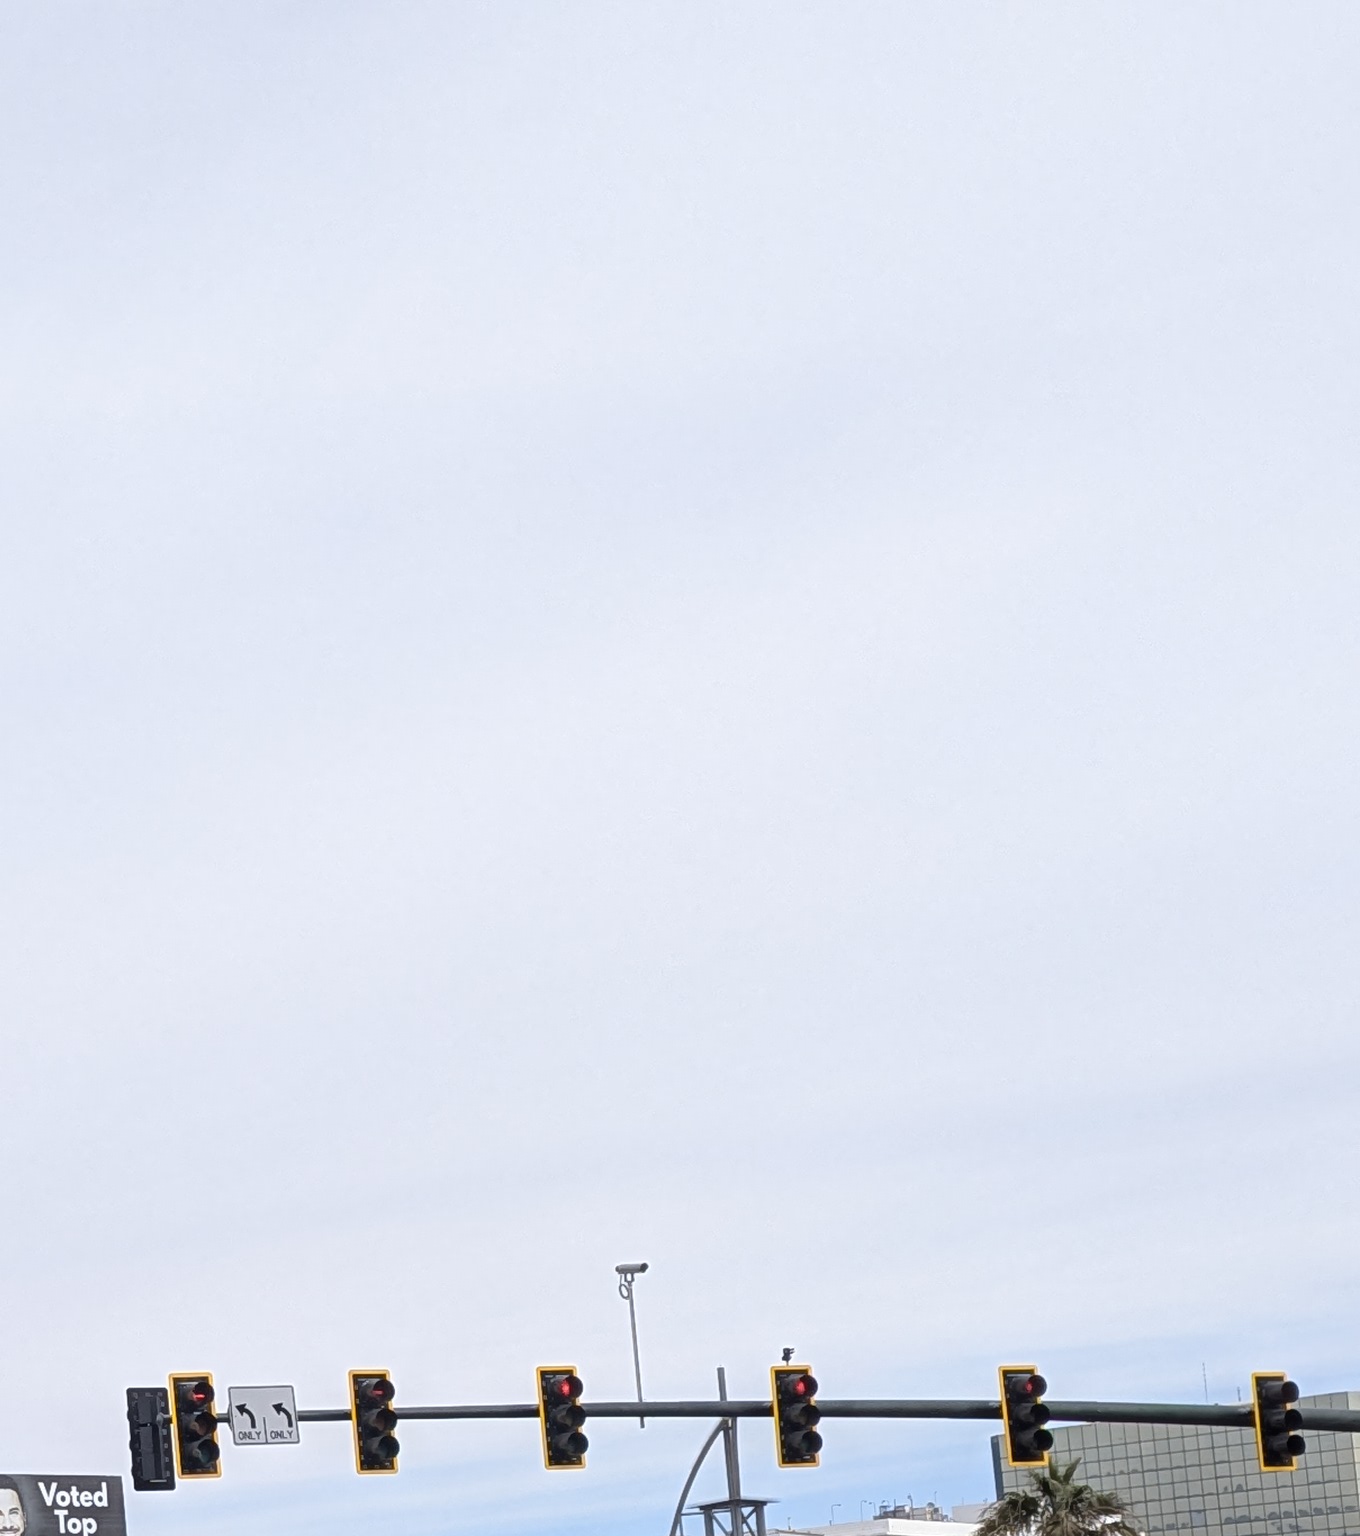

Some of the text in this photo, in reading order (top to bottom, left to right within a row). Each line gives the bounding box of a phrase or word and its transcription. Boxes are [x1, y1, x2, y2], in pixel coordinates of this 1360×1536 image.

[238, 1430, 262, 1441] ONLY
[269, 1429, 294, 1440] ONLY
[37, 1481, 109, 1508] Voted
